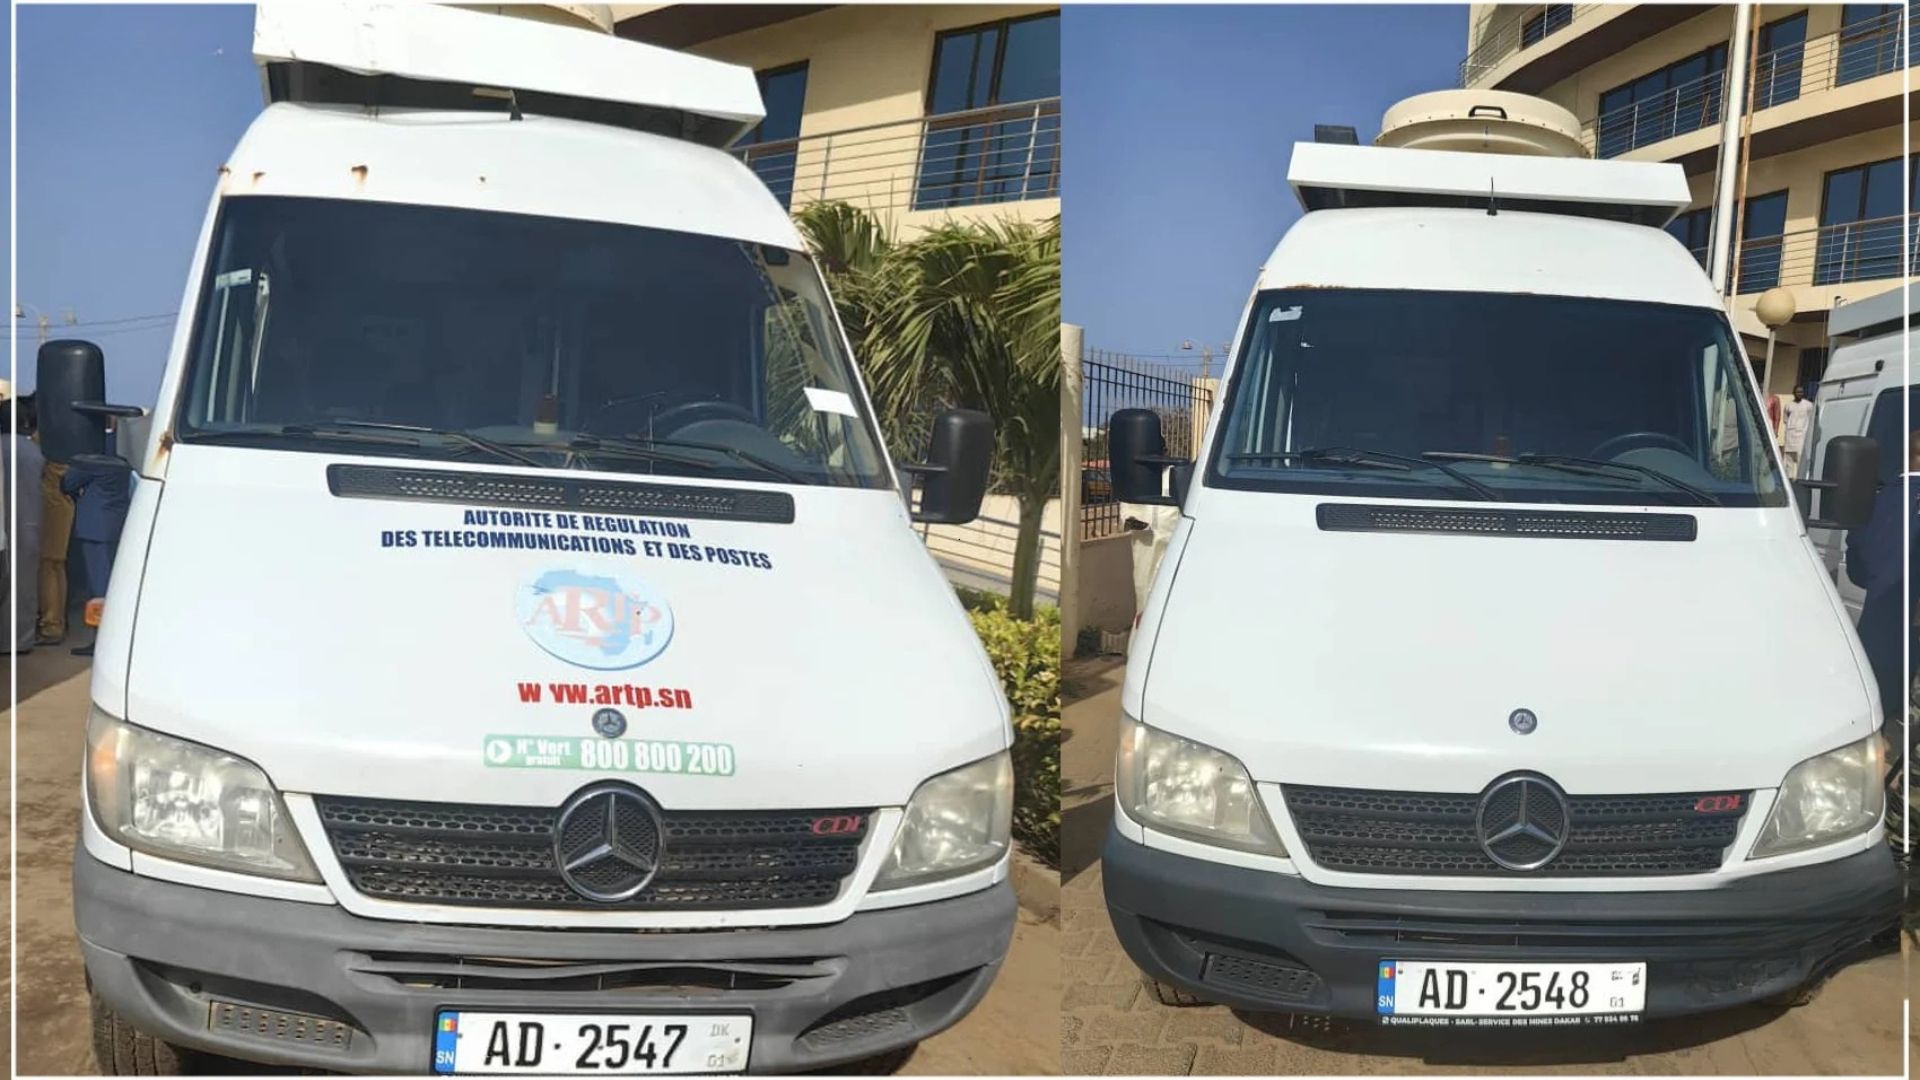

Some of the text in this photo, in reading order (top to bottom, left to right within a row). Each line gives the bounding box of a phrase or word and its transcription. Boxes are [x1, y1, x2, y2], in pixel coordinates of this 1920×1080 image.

[463, 510, 691, 538] AUTORITE DE REGULATION
[381, 531, 772, 569] DES TELECOMMUNICATIONS ET DES POSTES
[580, 739, 628, 770] 800
[635, 742, 682, 772] 800
[687, 745, 733, 774] 200
[1695, 795, 1740, 812] CDI
[812, 816, 861, 835] CDI
[1379, 968, 1590, 1010] SN AD 2548
[436, 1021, 688, 1069] SN AD 2547
